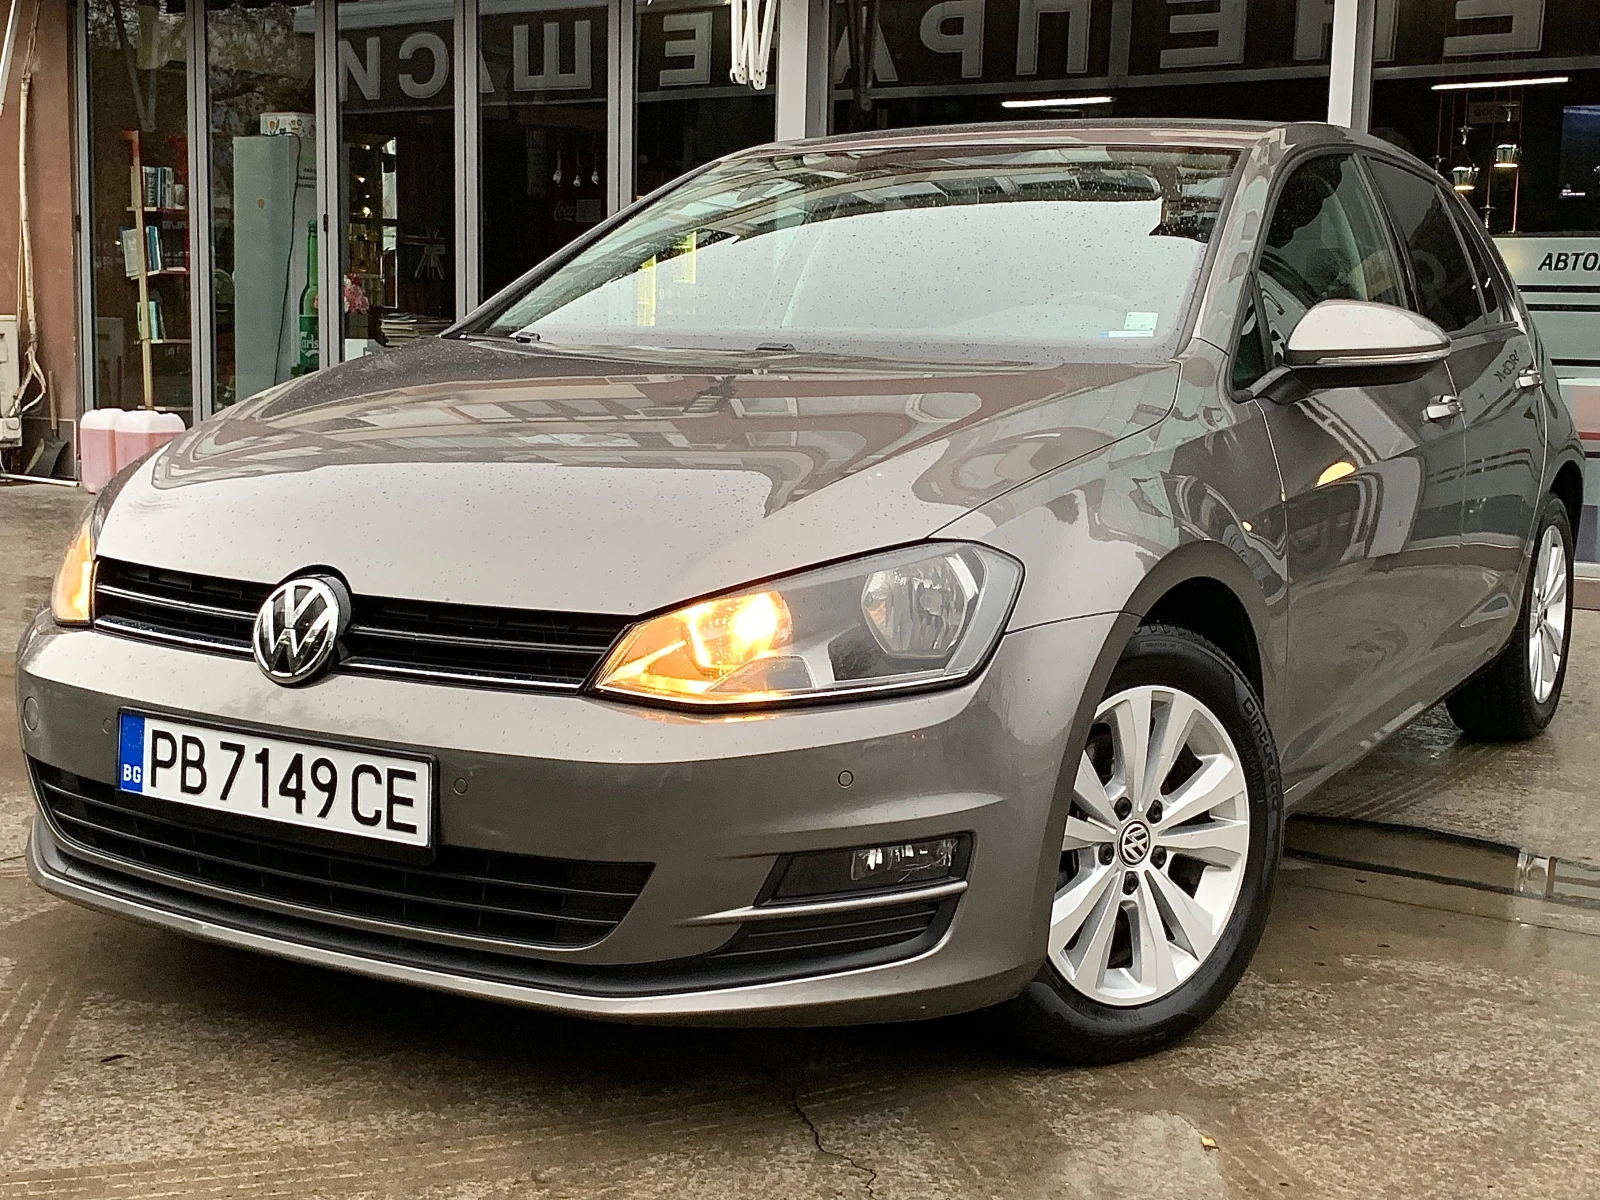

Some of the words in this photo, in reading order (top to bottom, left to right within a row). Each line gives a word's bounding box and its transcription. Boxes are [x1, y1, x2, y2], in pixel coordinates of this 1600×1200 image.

[1538, 252, 1600, 271] АВТО
[123, 763, 141, 783] BG
[150, 729, 208, 795] PB
[219, 741, 338, 818] 7149
[351, 764, 418, 834] CE
